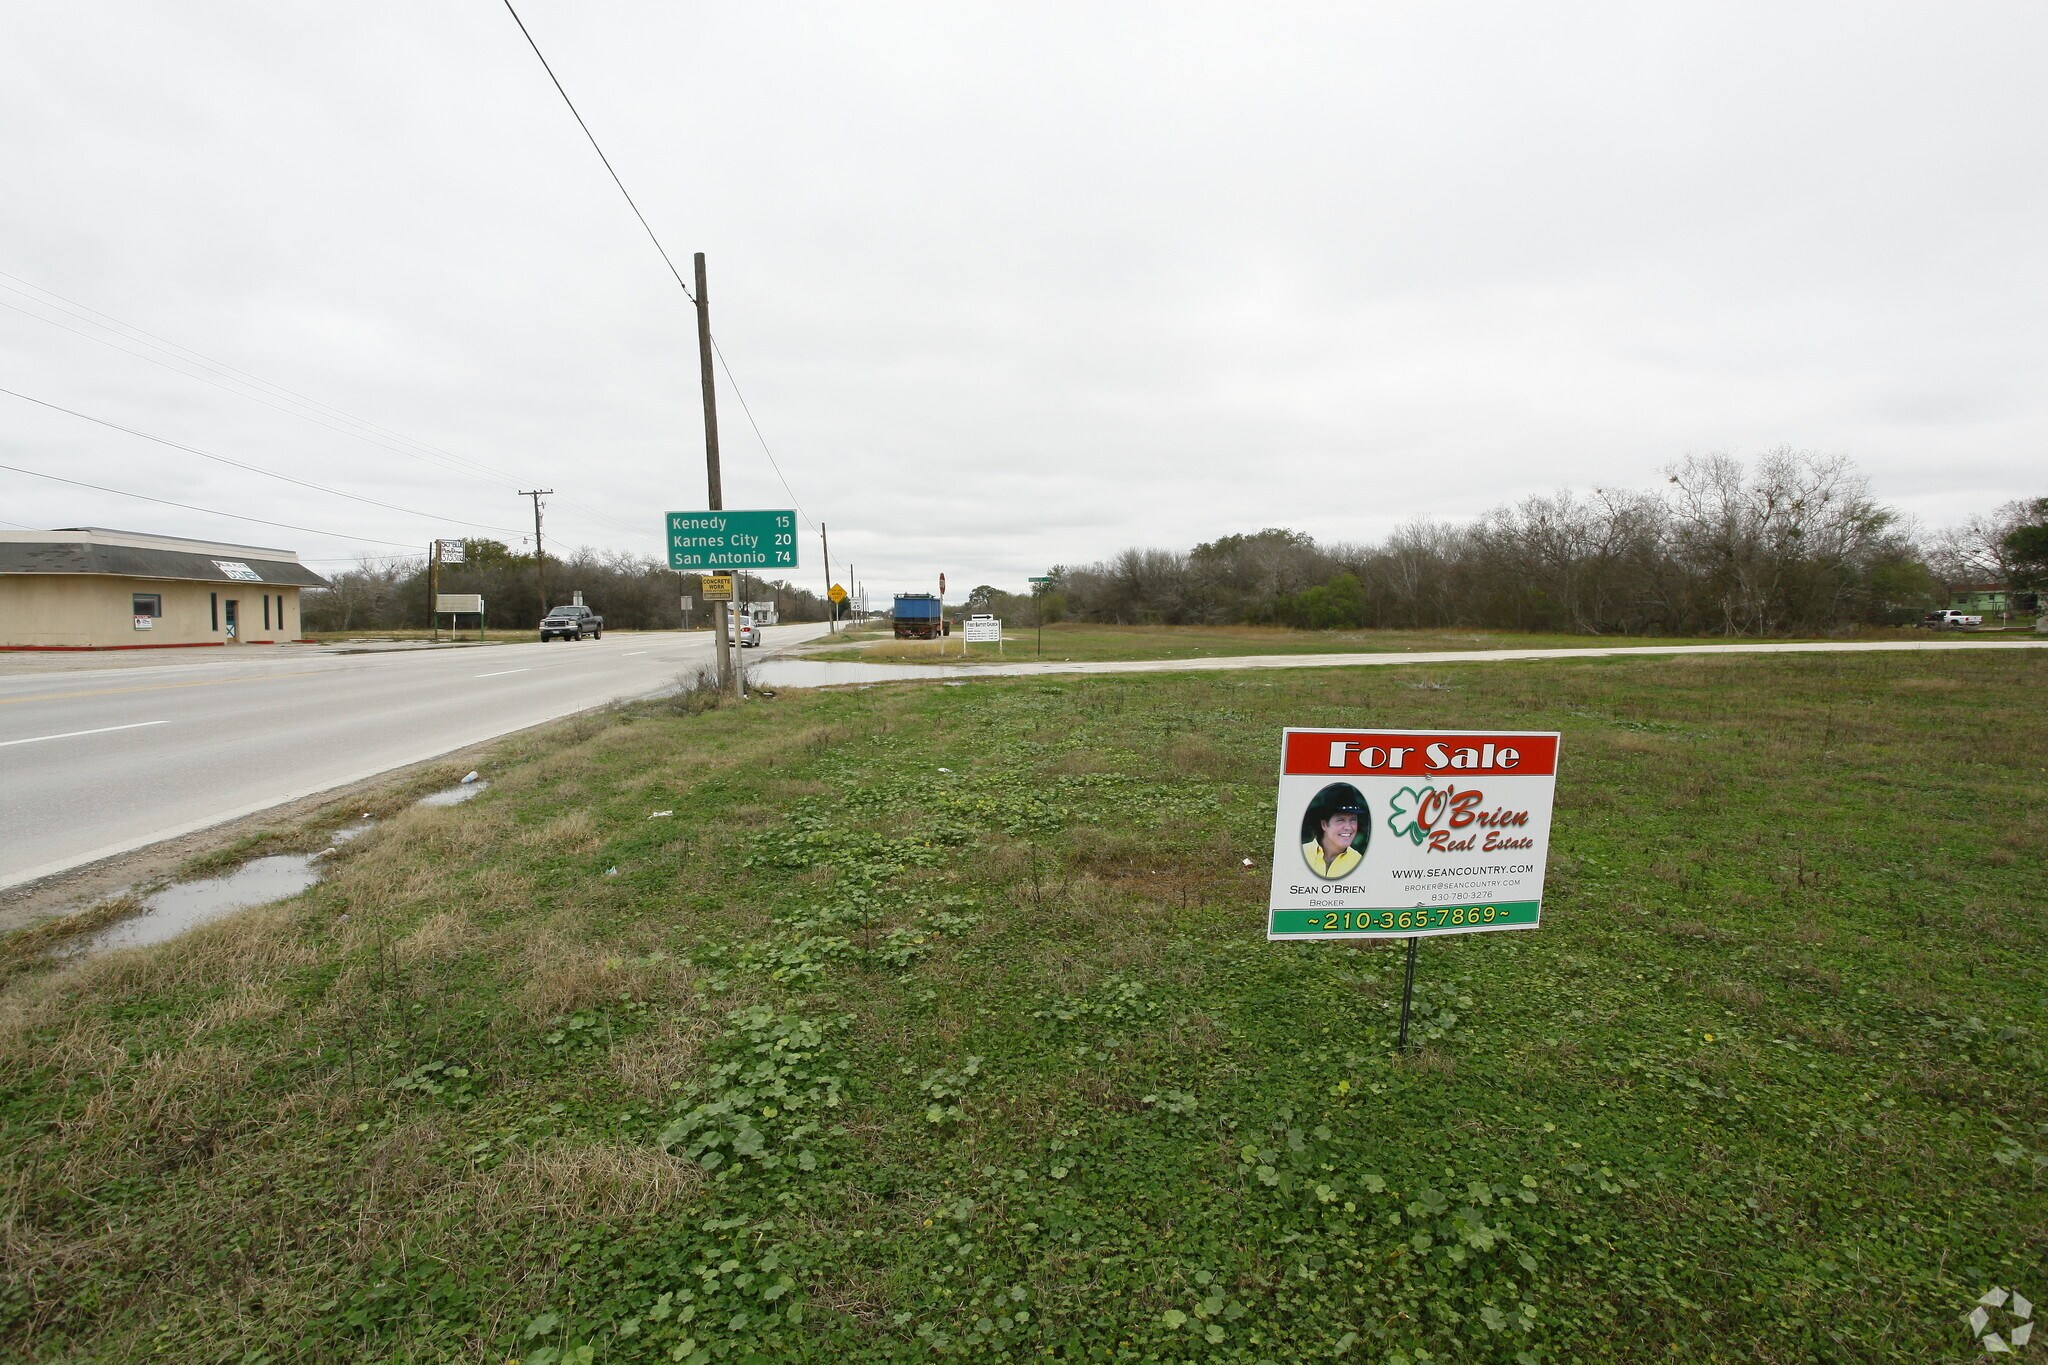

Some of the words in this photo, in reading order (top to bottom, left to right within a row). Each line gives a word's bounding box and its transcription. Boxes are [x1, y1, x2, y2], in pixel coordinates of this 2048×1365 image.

[673, 517, 726, 531] Kenedy
[776, 517, 790, 527] 15
[674, 536, 724, 547] Karnes
[731, 534, 758, 548] City
[775, 534, 791, 545] 20
[675, 553, 701, 564] San
[709, 551, 766, 563] Antonio
[775, 551, 791, 562] 74
[1328, 741, 1414, 768] For
[1424, 743, 1520, 770] Sale
[1417, 784, 1528, 829] O'Brien
[1427, 831, 1477, 853] Real
[1482, 831, 1533, 853] Estate
[1392, 865, 1534, 879] WWW.SEANCOUNTRY.COM
[1404, 880, 1521, 892] BROKER@SEANCOUNTRY.COM
[1431, 891, 1493, 902] 830-780-3276
